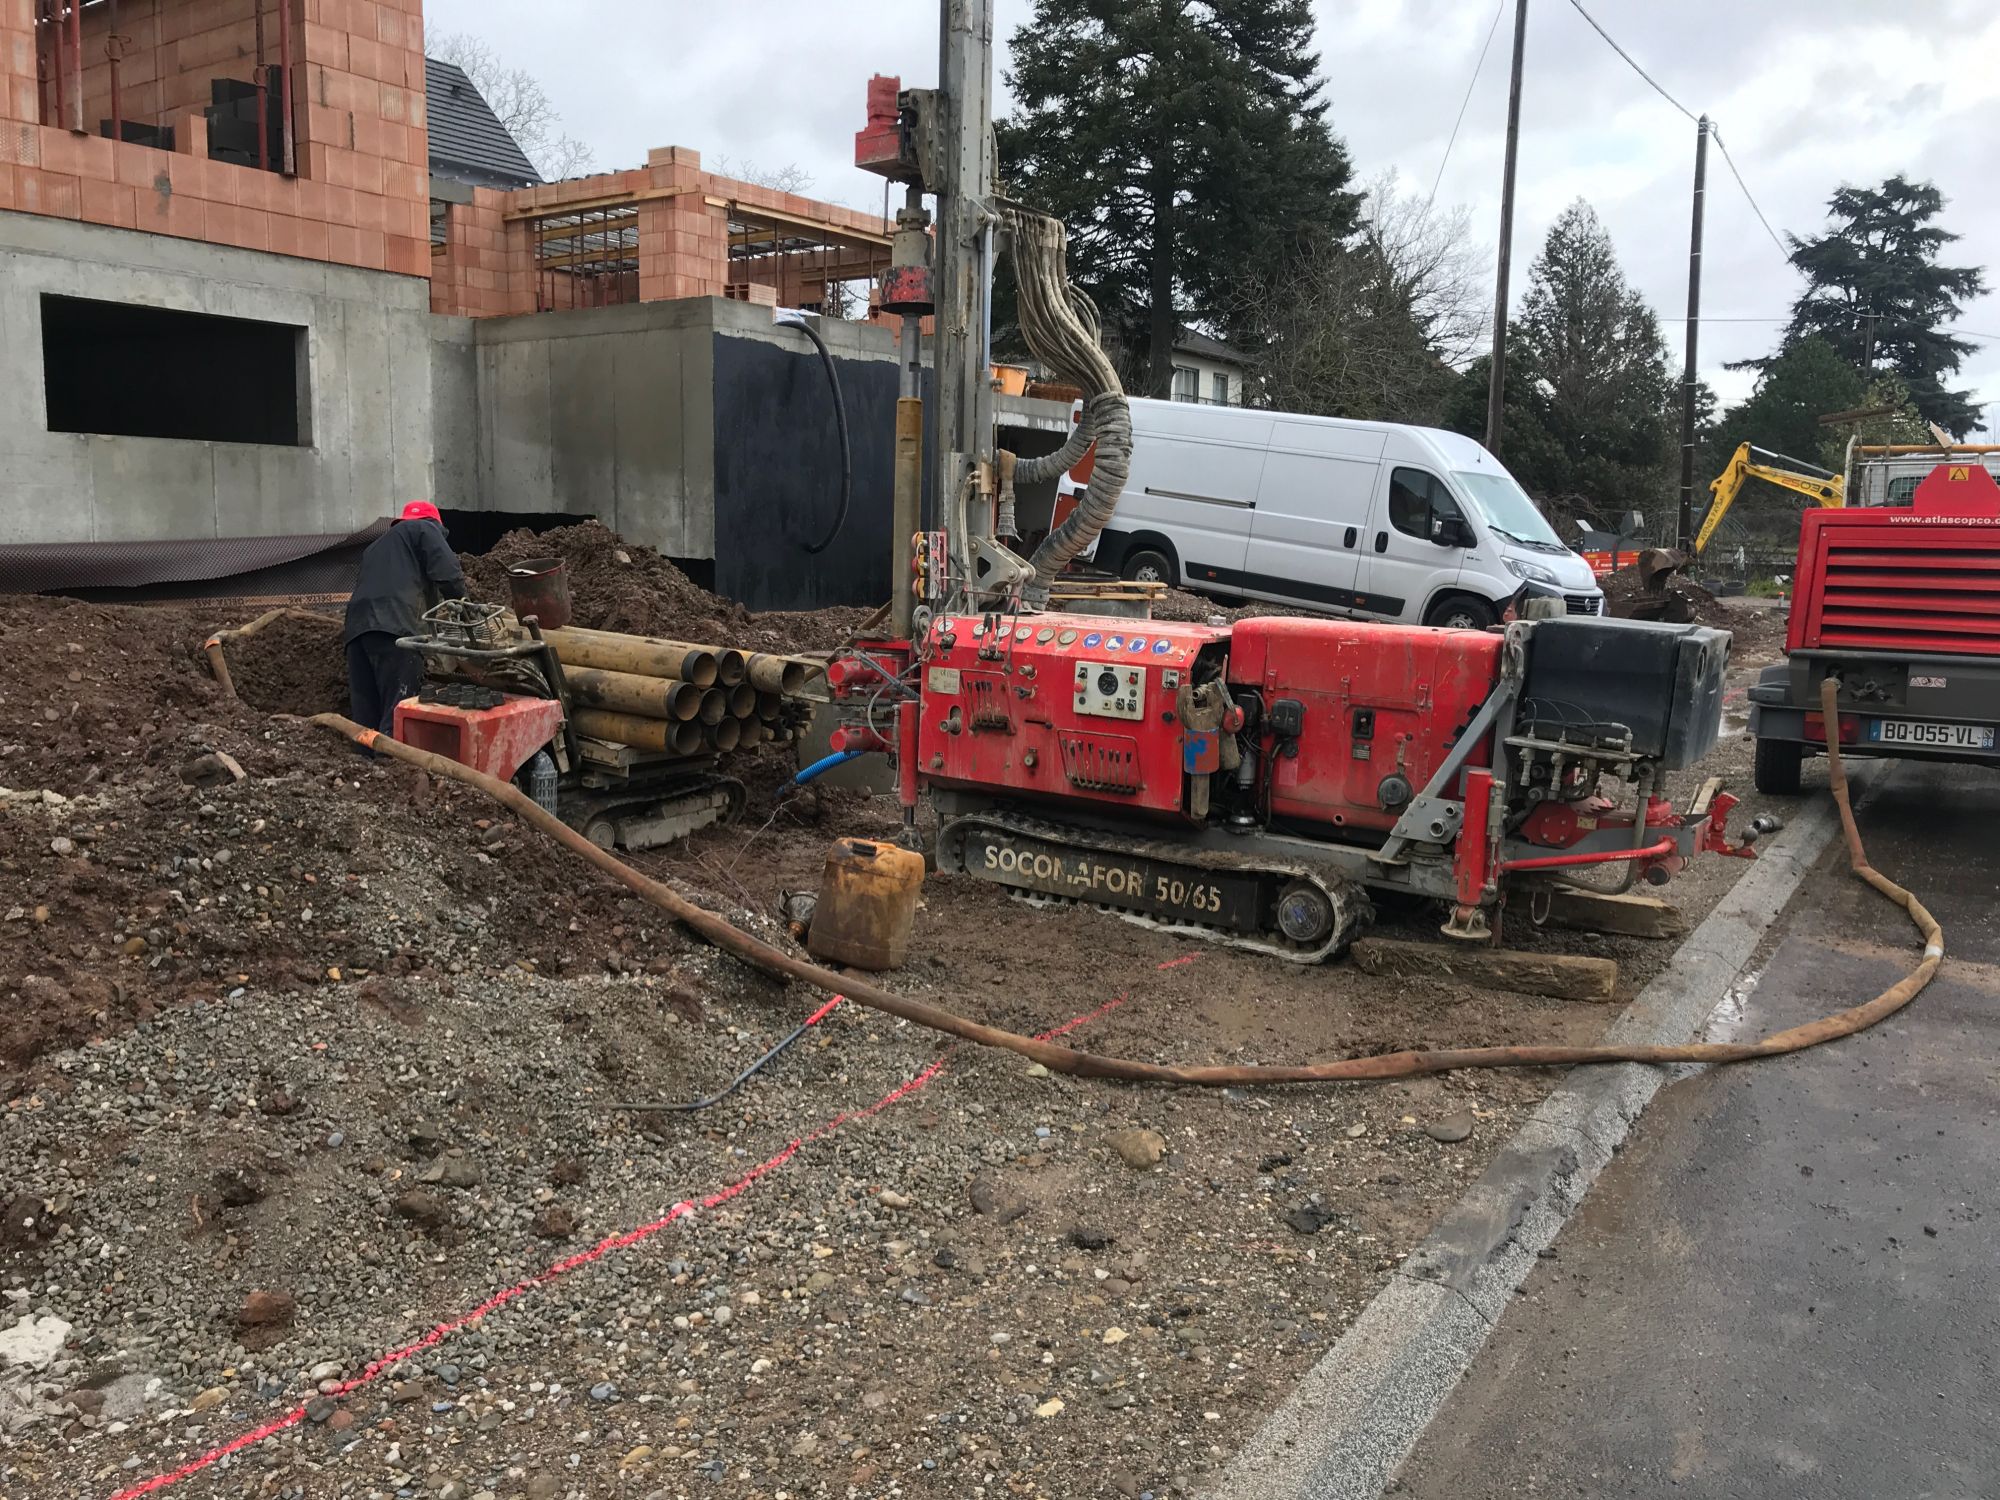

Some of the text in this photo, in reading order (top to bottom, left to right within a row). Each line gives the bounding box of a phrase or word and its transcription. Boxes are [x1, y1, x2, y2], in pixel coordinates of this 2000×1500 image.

[1782, 477, 1821, 492] 2503
[1884, 722, 1978, 745] BQ-055-VL
[1156, 876, 1222, 912] 50/65
